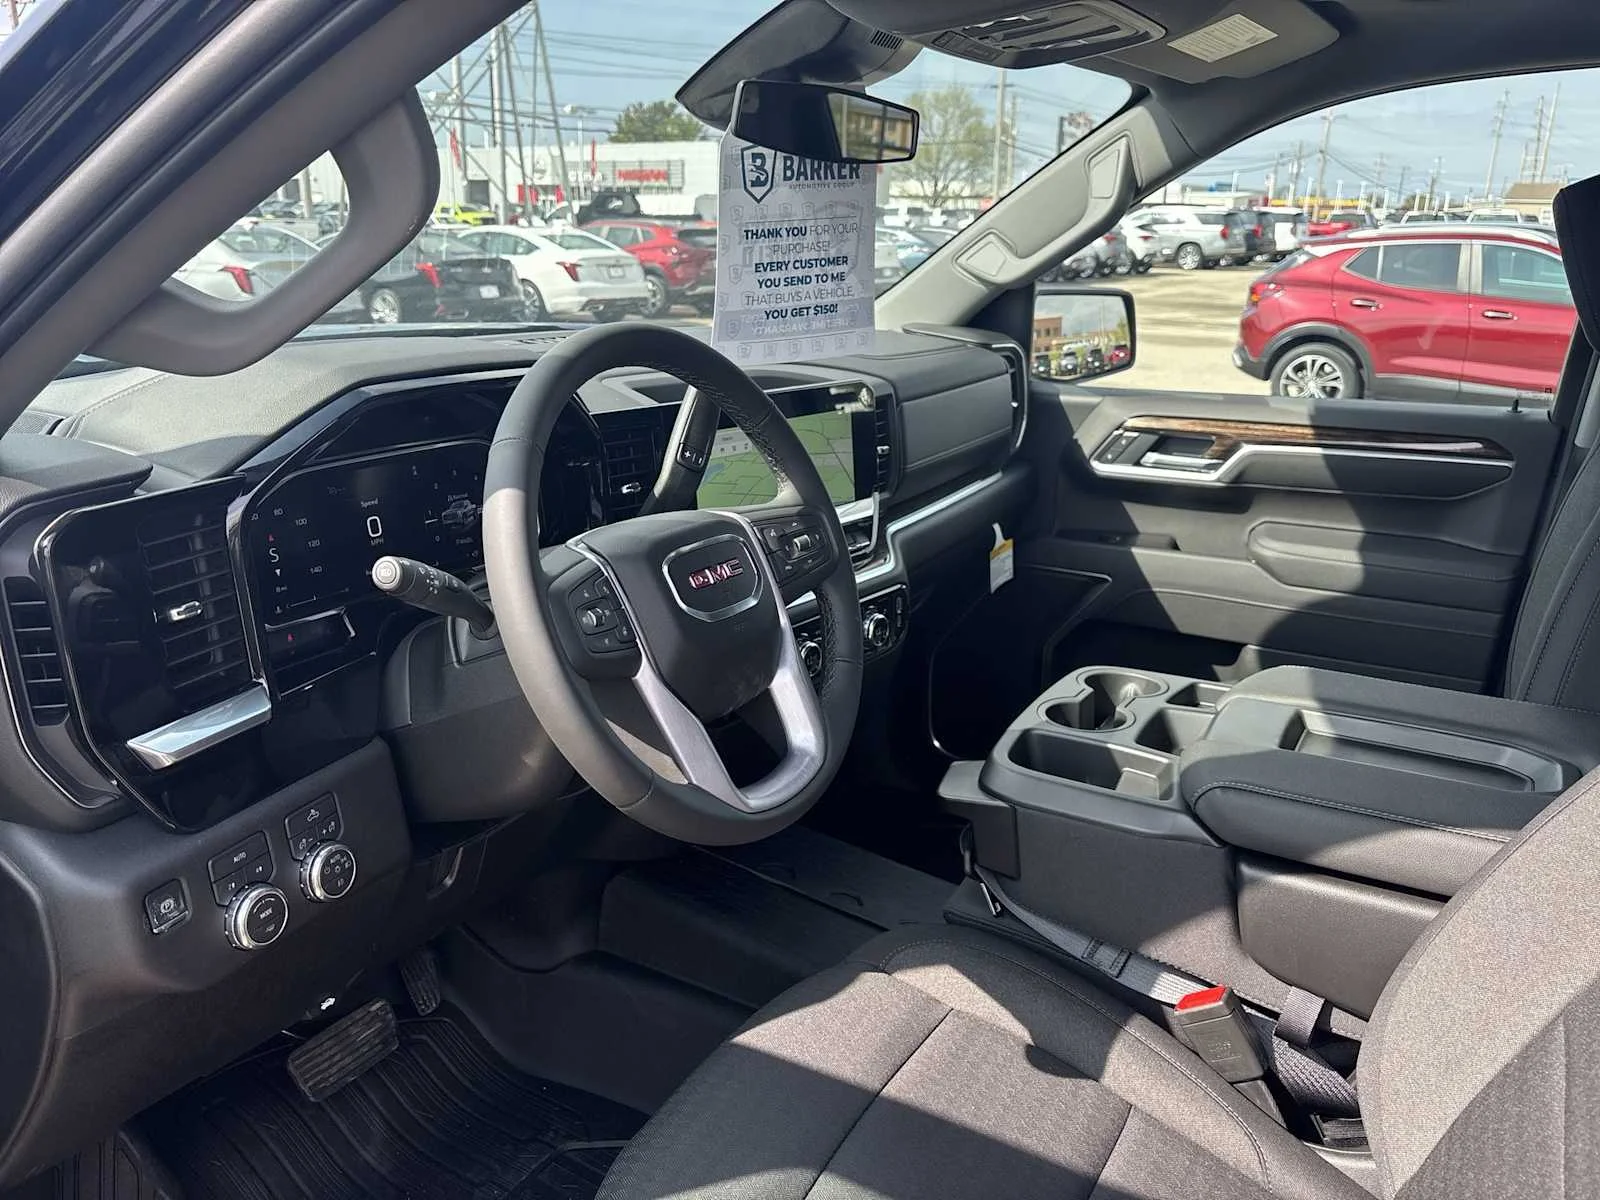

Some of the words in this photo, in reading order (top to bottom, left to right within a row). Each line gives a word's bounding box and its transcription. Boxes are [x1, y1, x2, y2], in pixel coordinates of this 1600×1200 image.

[782, 155, 861, 181] BARKER
[744, 227, 783, 240] THANK
[785, 226, 807, 237] YOU
[809, 224, 831, 236] FOR
[832, 222, 858, 234] YOUR
[773, 240, 831, 255] PURCHASE!
[754, 260, 791, 273] EVERY
[792, 255, 849, 270] CUSTOMER
[757, 278, 781, 289] YOU
[783, 275, 812, 287] SEND
[814, 273, 829, 284] TO
[831, 271, 846, 282] ME
[745, 293, 774, 306] THAT
[775, 290, 803, 304] BUYS
[803, 290, 812, 301] A
[764, 308, 788, 320] YOU
[790, 306, 812, 318] GET
[813, 303, 839, 317] $150!
[295, 517, 308, 526] 100
[366, 515, 382, 538] 0
[307, 538, 321, 548] 120
[268, 547, 280, 563] S
[688, 559, 744, 589] GMC
[233, 852, 247, 863] AUTO
